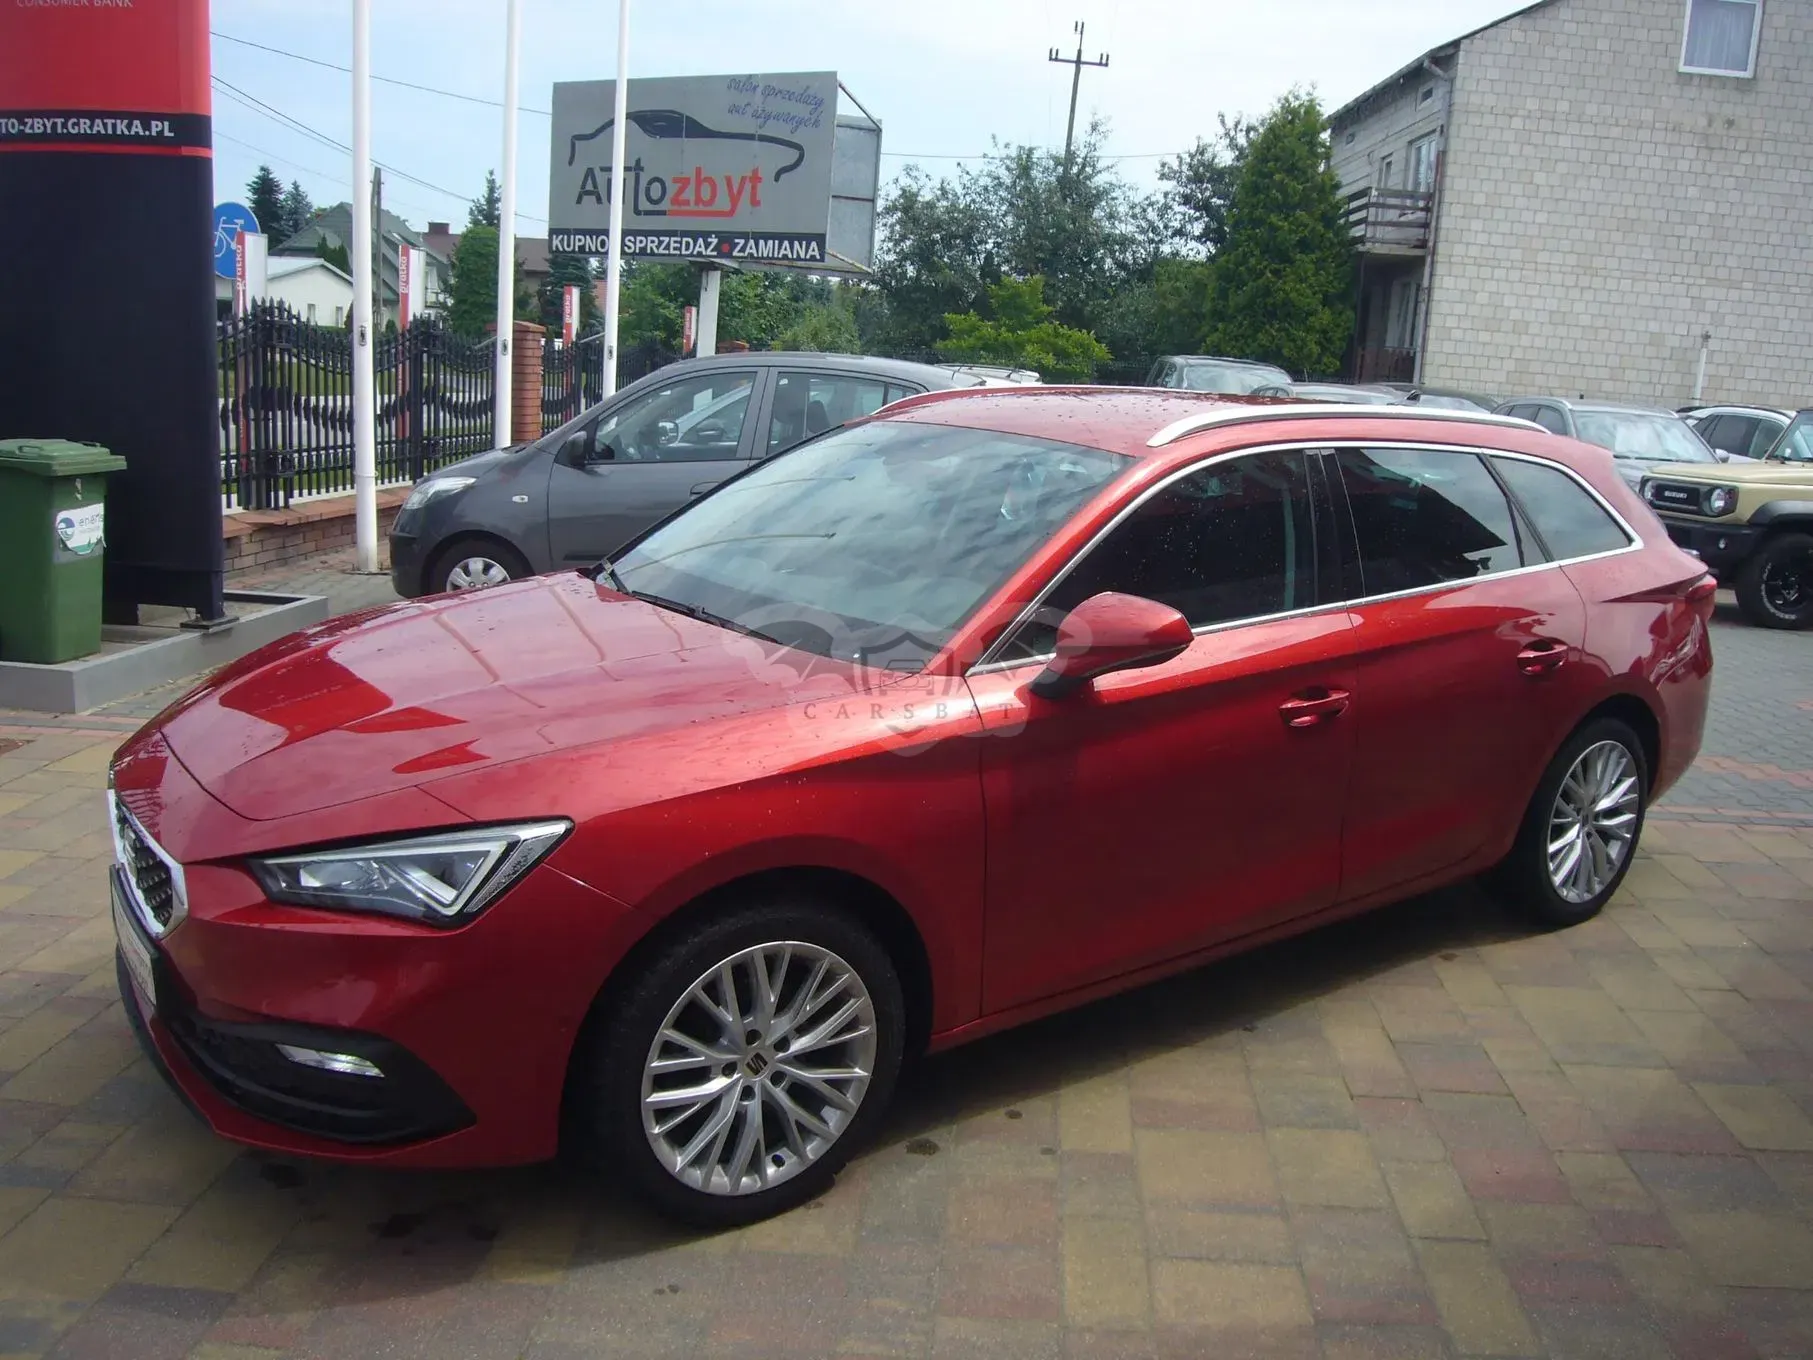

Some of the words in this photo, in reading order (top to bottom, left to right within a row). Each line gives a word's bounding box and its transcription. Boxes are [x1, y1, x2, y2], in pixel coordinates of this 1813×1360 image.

[94, 0, 133, 8] BANK
[0, 117, 175, 137] TO-ZBYT.GRATKA.PL
[552, 234, 609, 252] KUPNO
[624, 234, 718, 256] SPRZEDAŻ
[732, 238, 820, 260] ZAMIANA
